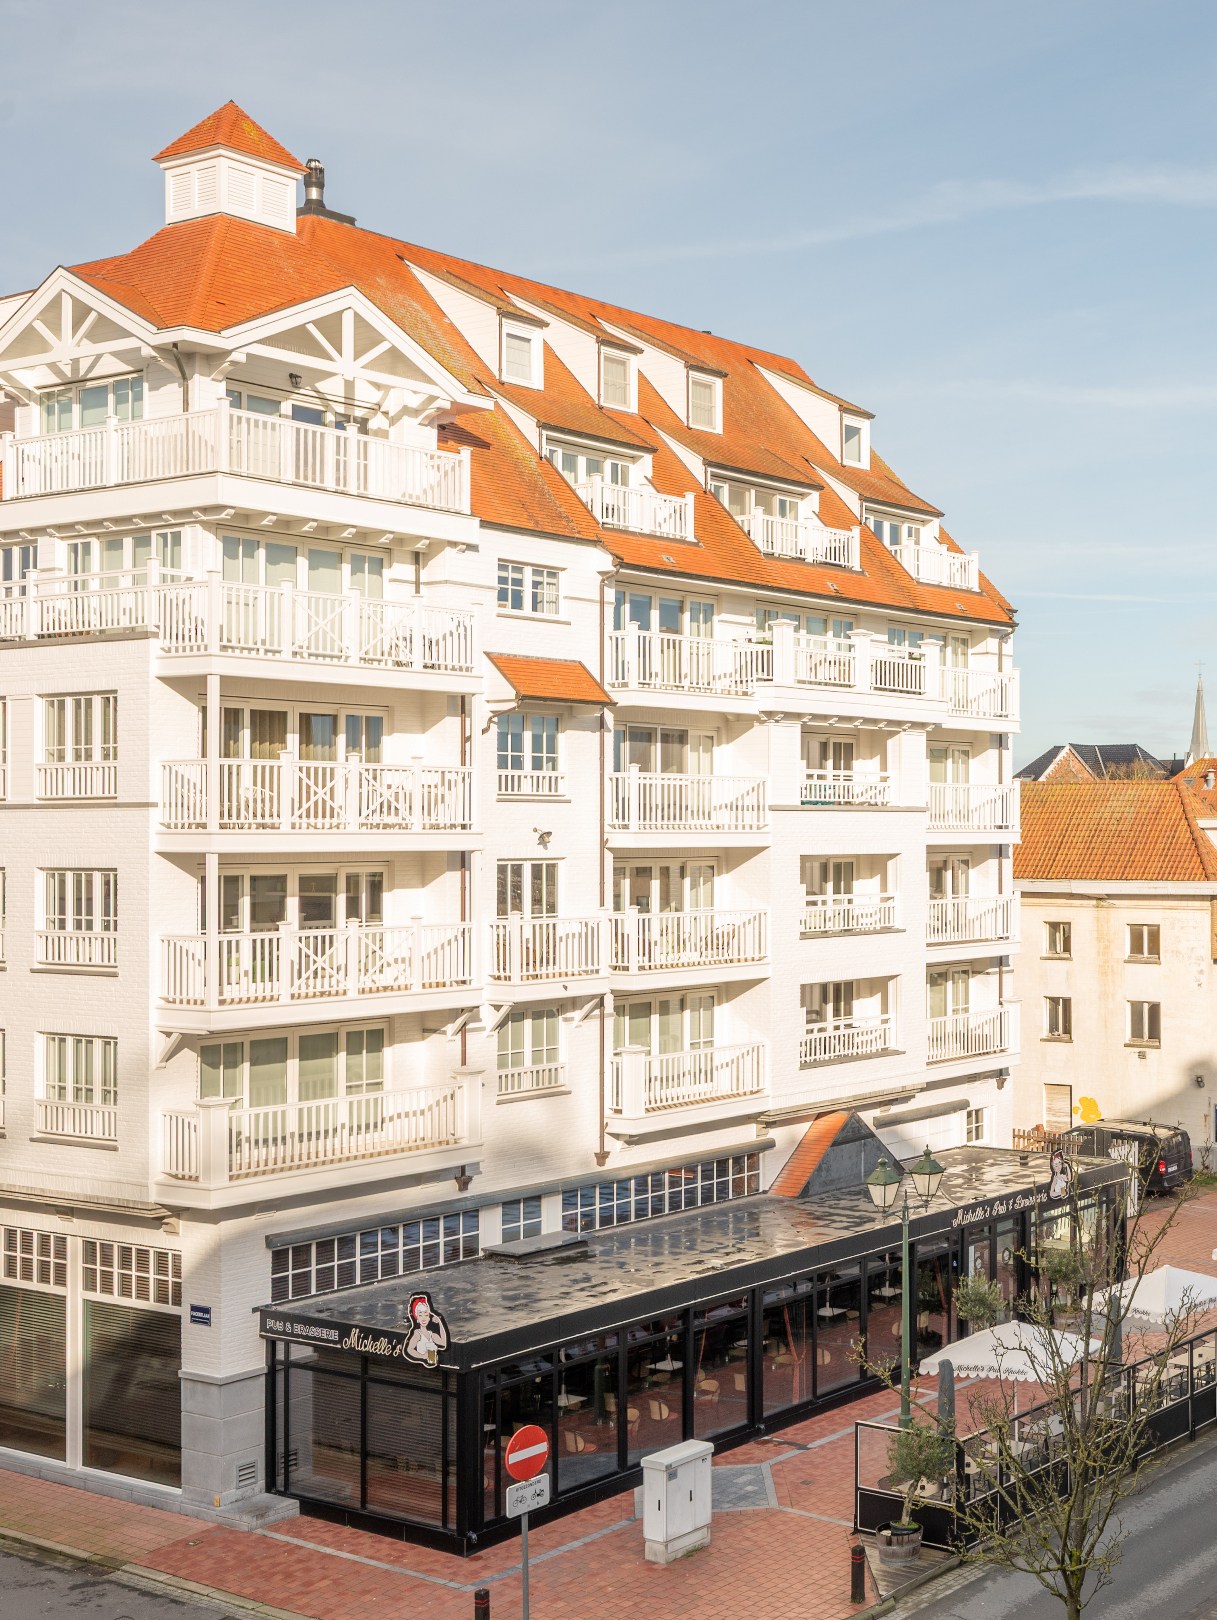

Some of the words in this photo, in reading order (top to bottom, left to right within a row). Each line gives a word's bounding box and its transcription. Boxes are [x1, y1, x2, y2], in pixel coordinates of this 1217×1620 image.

[266, 1318, 284, 1332] PUB
[285, 1322, 292, 1333] &
[293, 1323, 339, 1341] BRASSERIE
[342, 1327, 402, 1357] Michelle's
